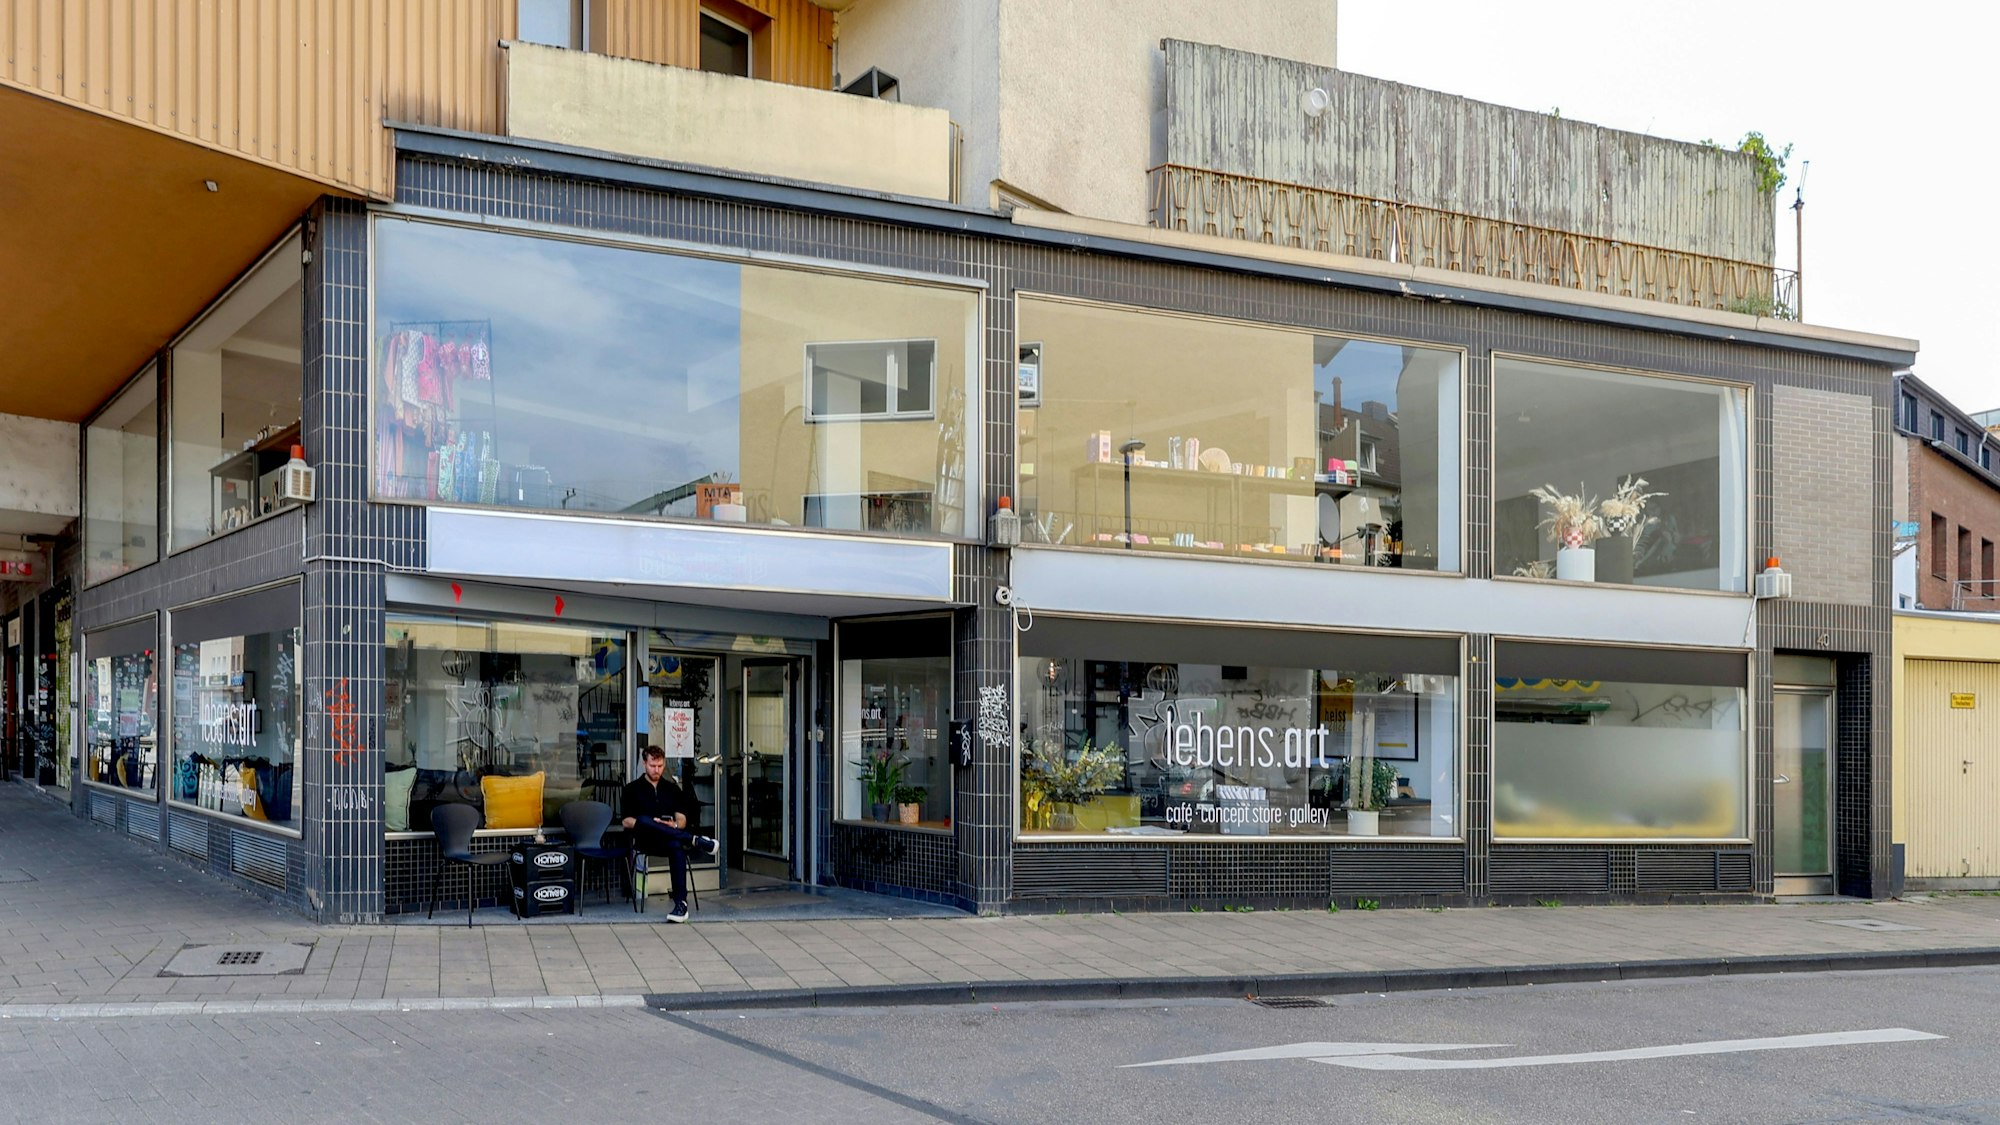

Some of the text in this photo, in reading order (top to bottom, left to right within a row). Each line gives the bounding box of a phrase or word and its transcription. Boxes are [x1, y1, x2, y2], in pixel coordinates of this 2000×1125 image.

[1816, 633, 1829, 648] 40
[201, 690, 257, 747] lebens.art
[1167, 710, 1329, 769] lebens.art
[1166, 802, 1329, 827] café concept store gallery
